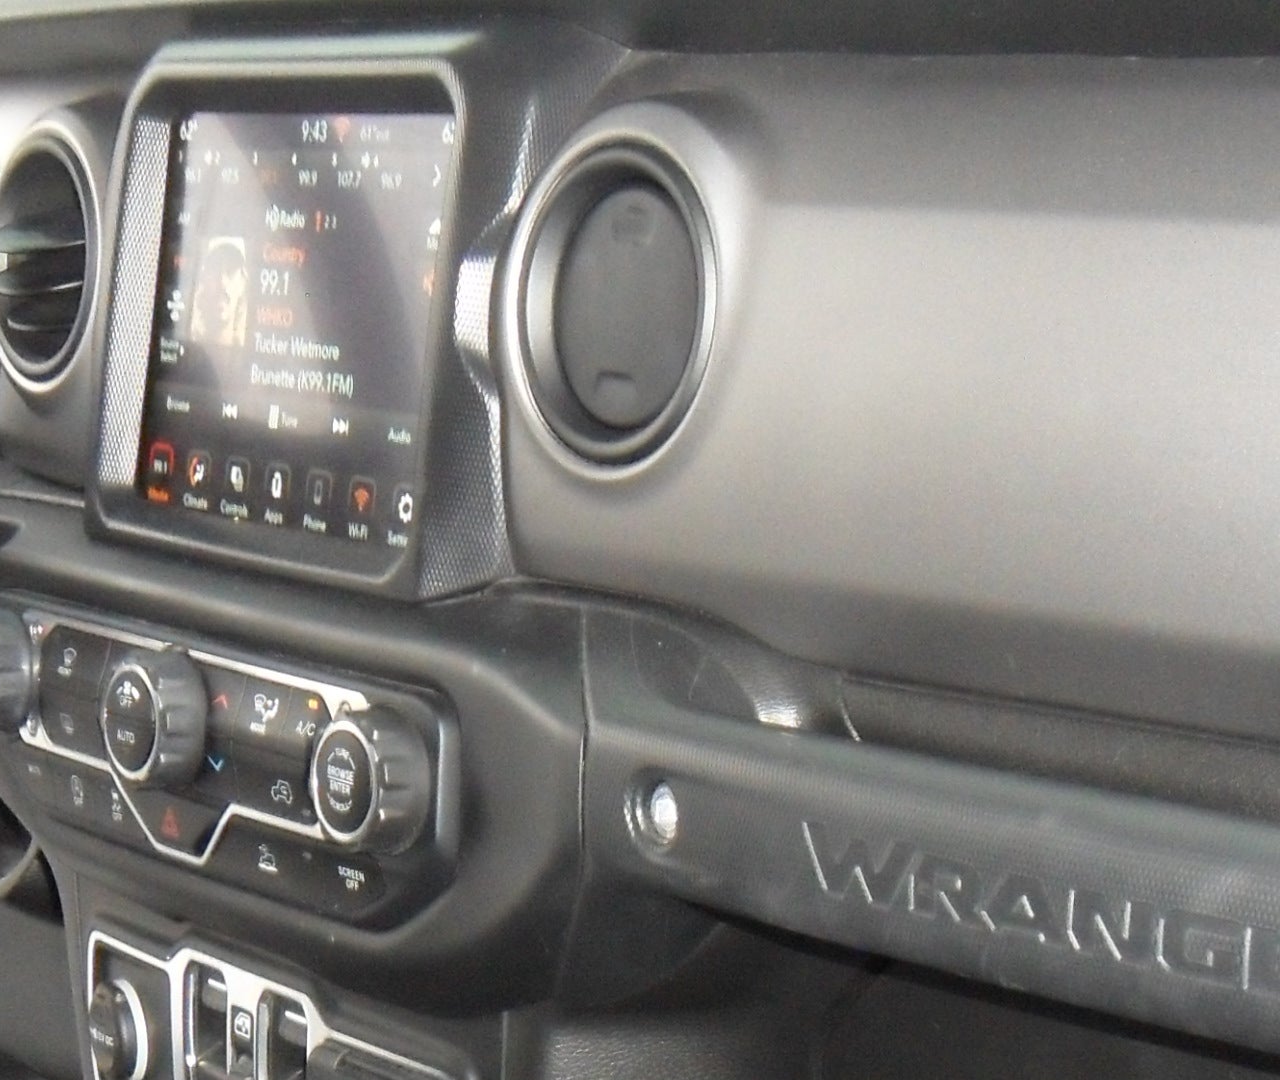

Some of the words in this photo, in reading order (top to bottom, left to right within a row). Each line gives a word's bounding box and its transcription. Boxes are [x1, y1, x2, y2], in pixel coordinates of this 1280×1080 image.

[302, 119, 328, 143] 9:43
[260, 267, 290, 296] 99.1
[255, 331, 288, 355] Tucker
[290, 335, 340, 361] Wetmore
[251, 362, 295, 389] Brunette
[297, 369, 354, 399] (K99.1FM)
[116, 728, 135, 744] AUTO
[295, 719, 316, 737] A/C
[327, 763, 355, 782] BROWSE
[329, 779, 351, 796] ENTER
[337, 865, 366, 884] SCREEN
[345, 878, 359, 891] OFF
